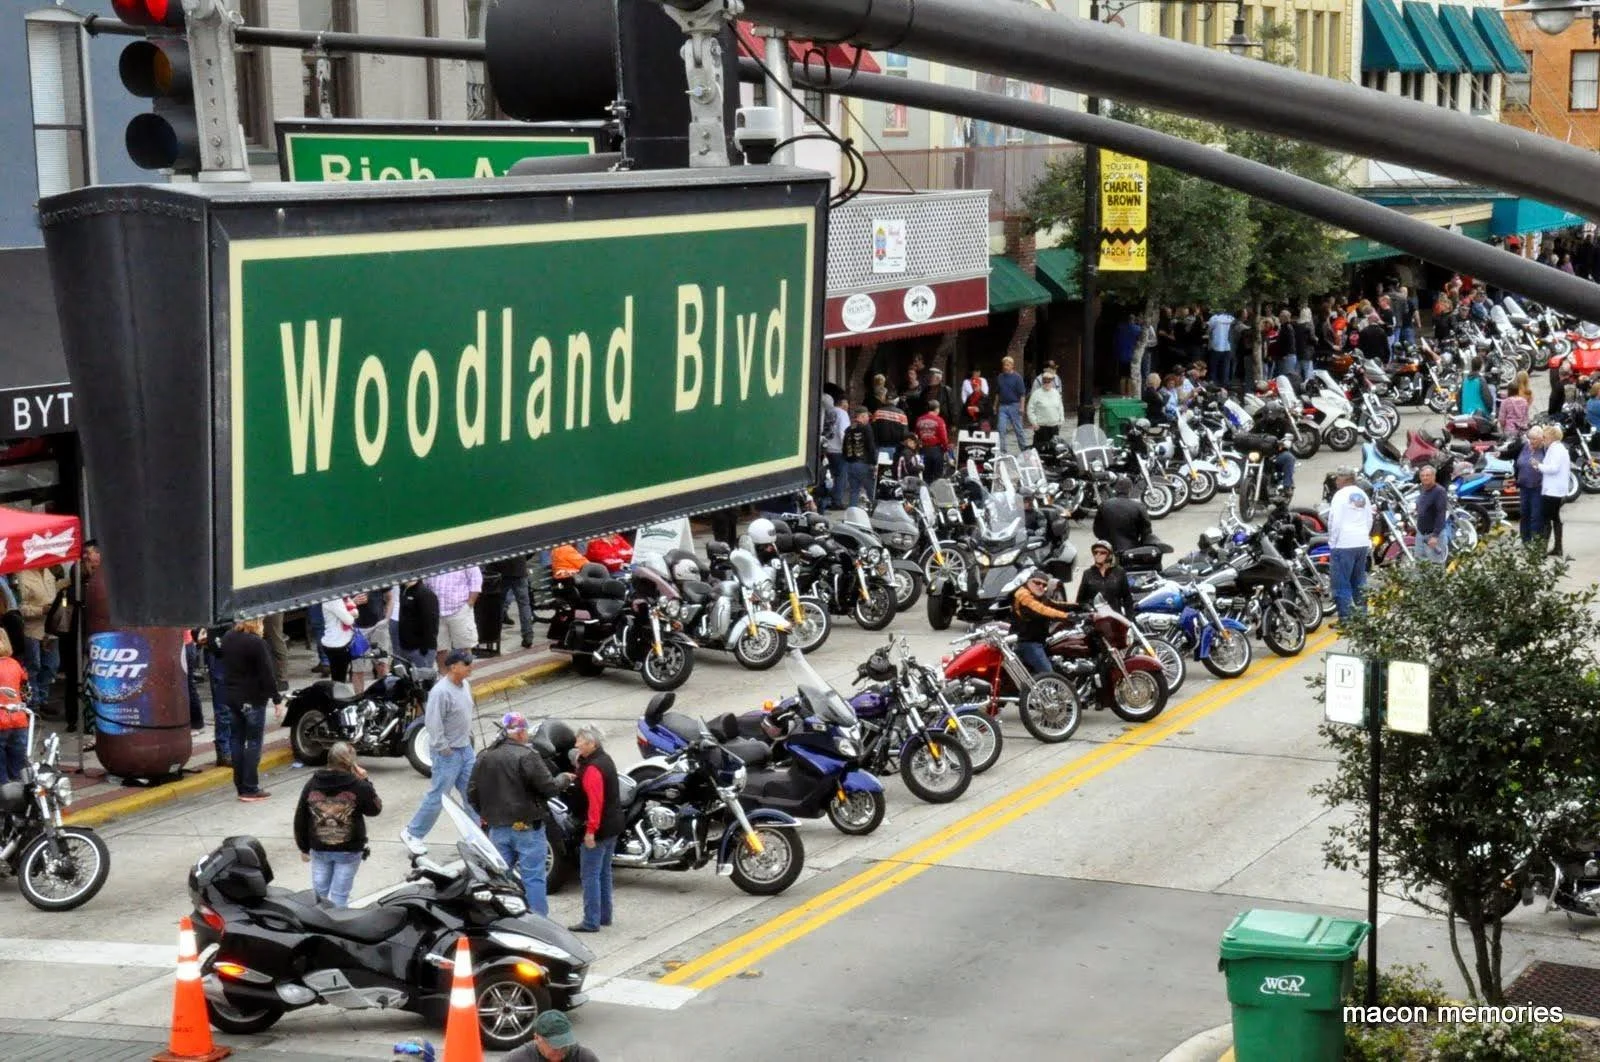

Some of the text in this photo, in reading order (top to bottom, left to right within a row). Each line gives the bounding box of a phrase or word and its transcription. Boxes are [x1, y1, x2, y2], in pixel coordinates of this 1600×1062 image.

[473, 156, 509, 180] A
[1103, 181, 1144, 193] CHARLIE
[1107, 194, 1142, 206] BROWN
[280, 279, 788, 476] Woodland Blvd
[90, 645, 138, 662] BUD
[1264, 976, 1301, 992] WCA
